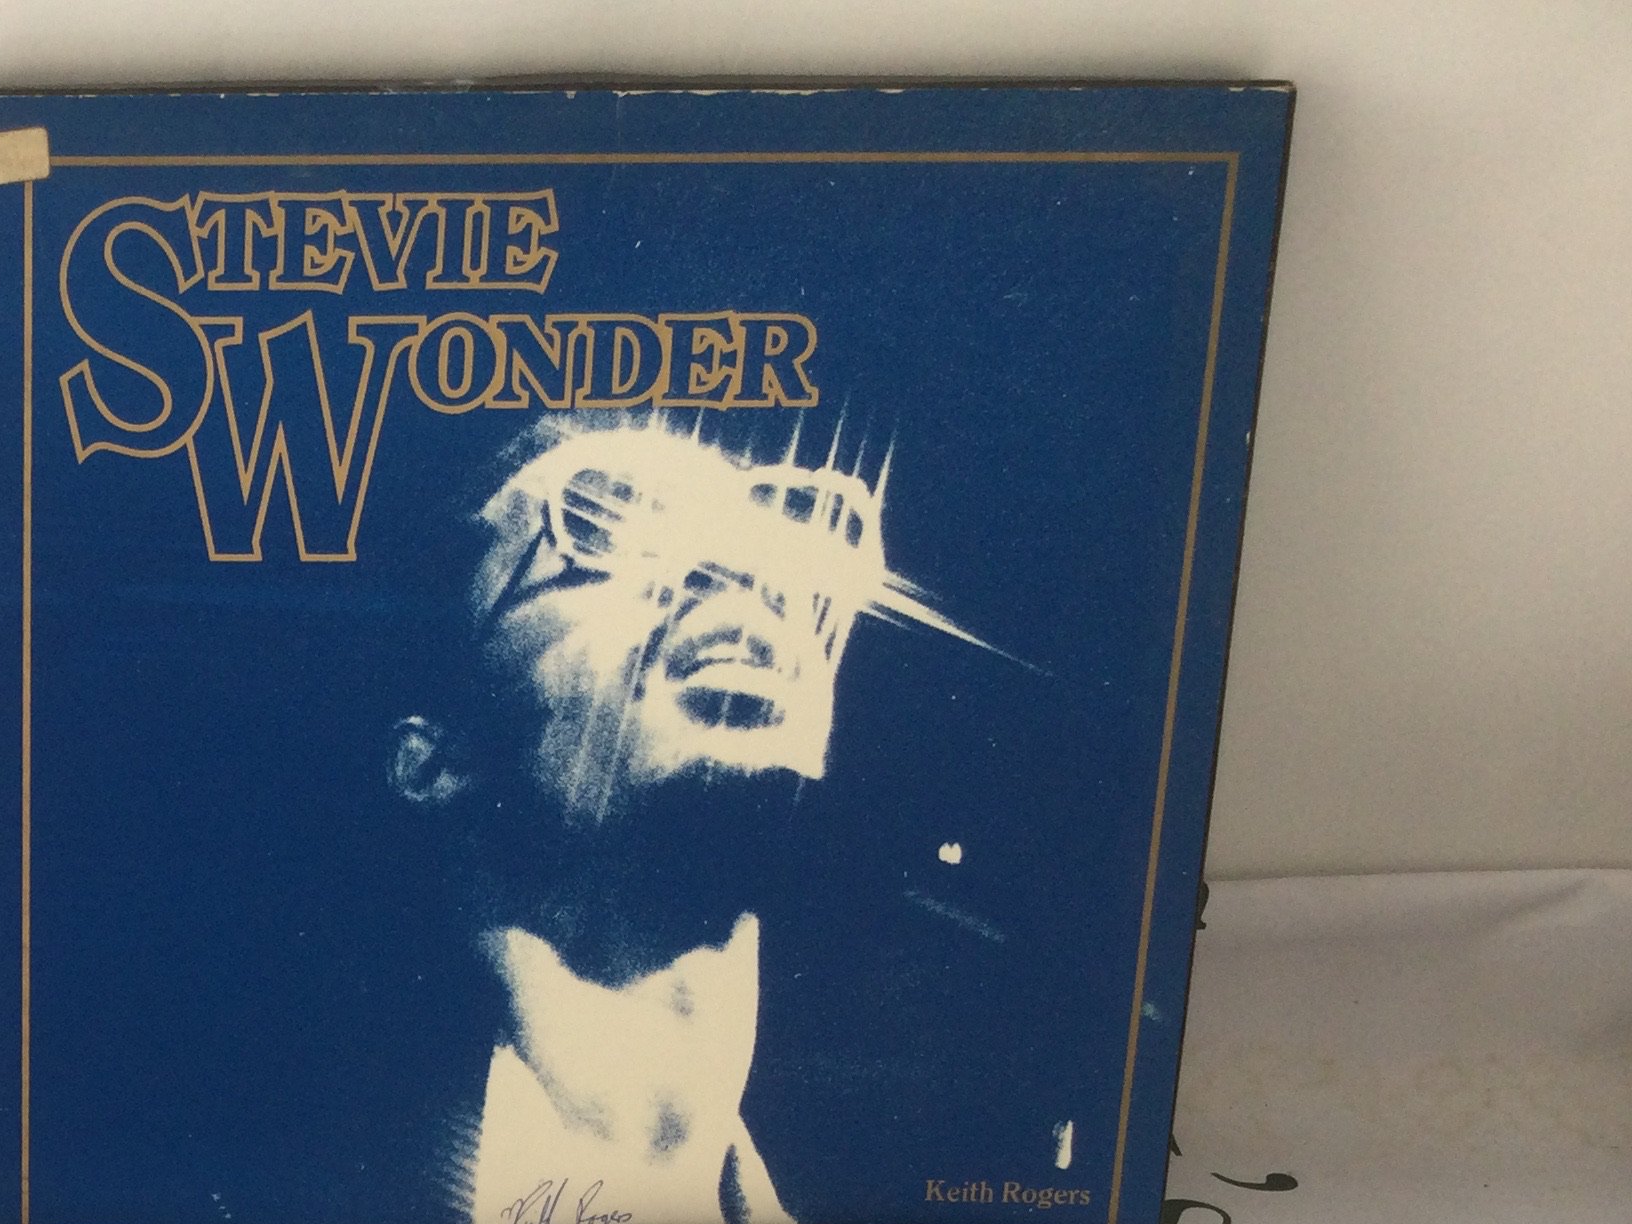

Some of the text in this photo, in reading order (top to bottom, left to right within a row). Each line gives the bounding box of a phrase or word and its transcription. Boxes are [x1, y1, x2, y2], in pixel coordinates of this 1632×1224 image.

[59, 189, 559, 462] STEVIE
[189, 311, 819, 563] WONDER
[924, 1179, 1091, 1209] Keith Rogers
